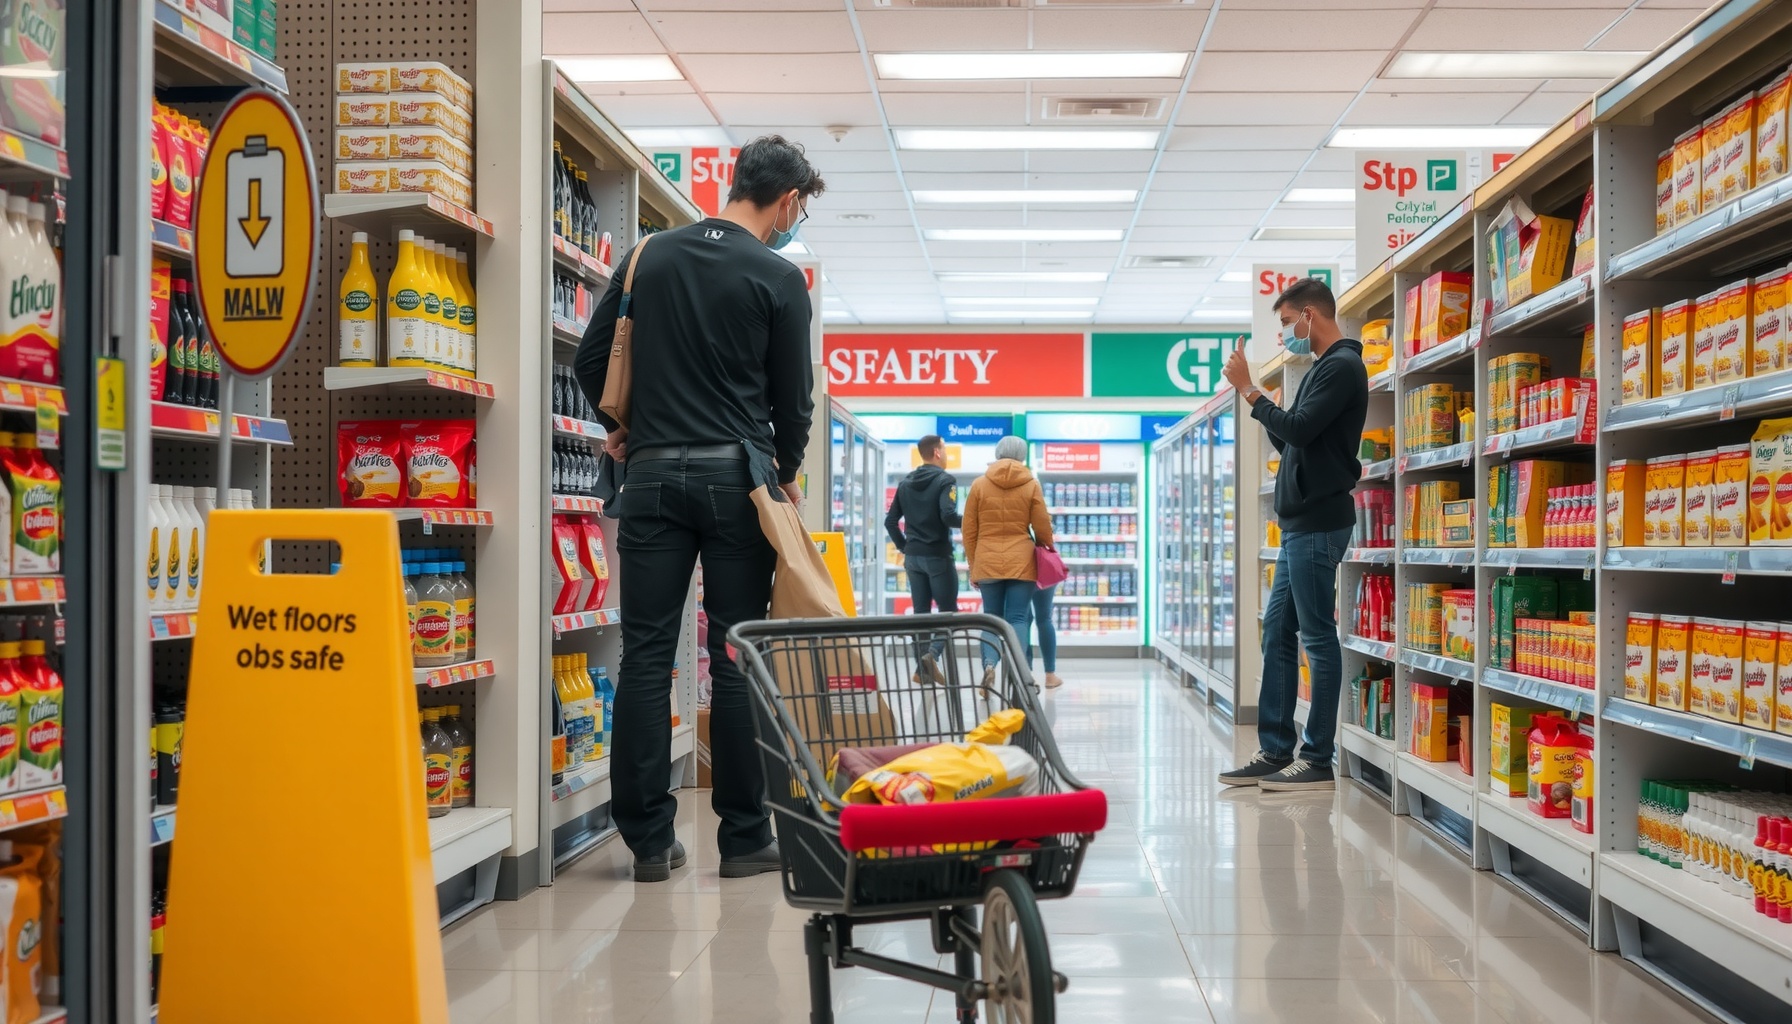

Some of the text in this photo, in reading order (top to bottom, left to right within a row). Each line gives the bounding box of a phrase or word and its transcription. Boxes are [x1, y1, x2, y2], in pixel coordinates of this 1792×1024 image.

[1363, 160, 1418, 197] Stp
[224, 286, 285, 317] MALW
[829, 348, 998, 385] SFAETY
[227, 604, 357, 633] Wet floors
[236, 643, 344, 671] obs safe
